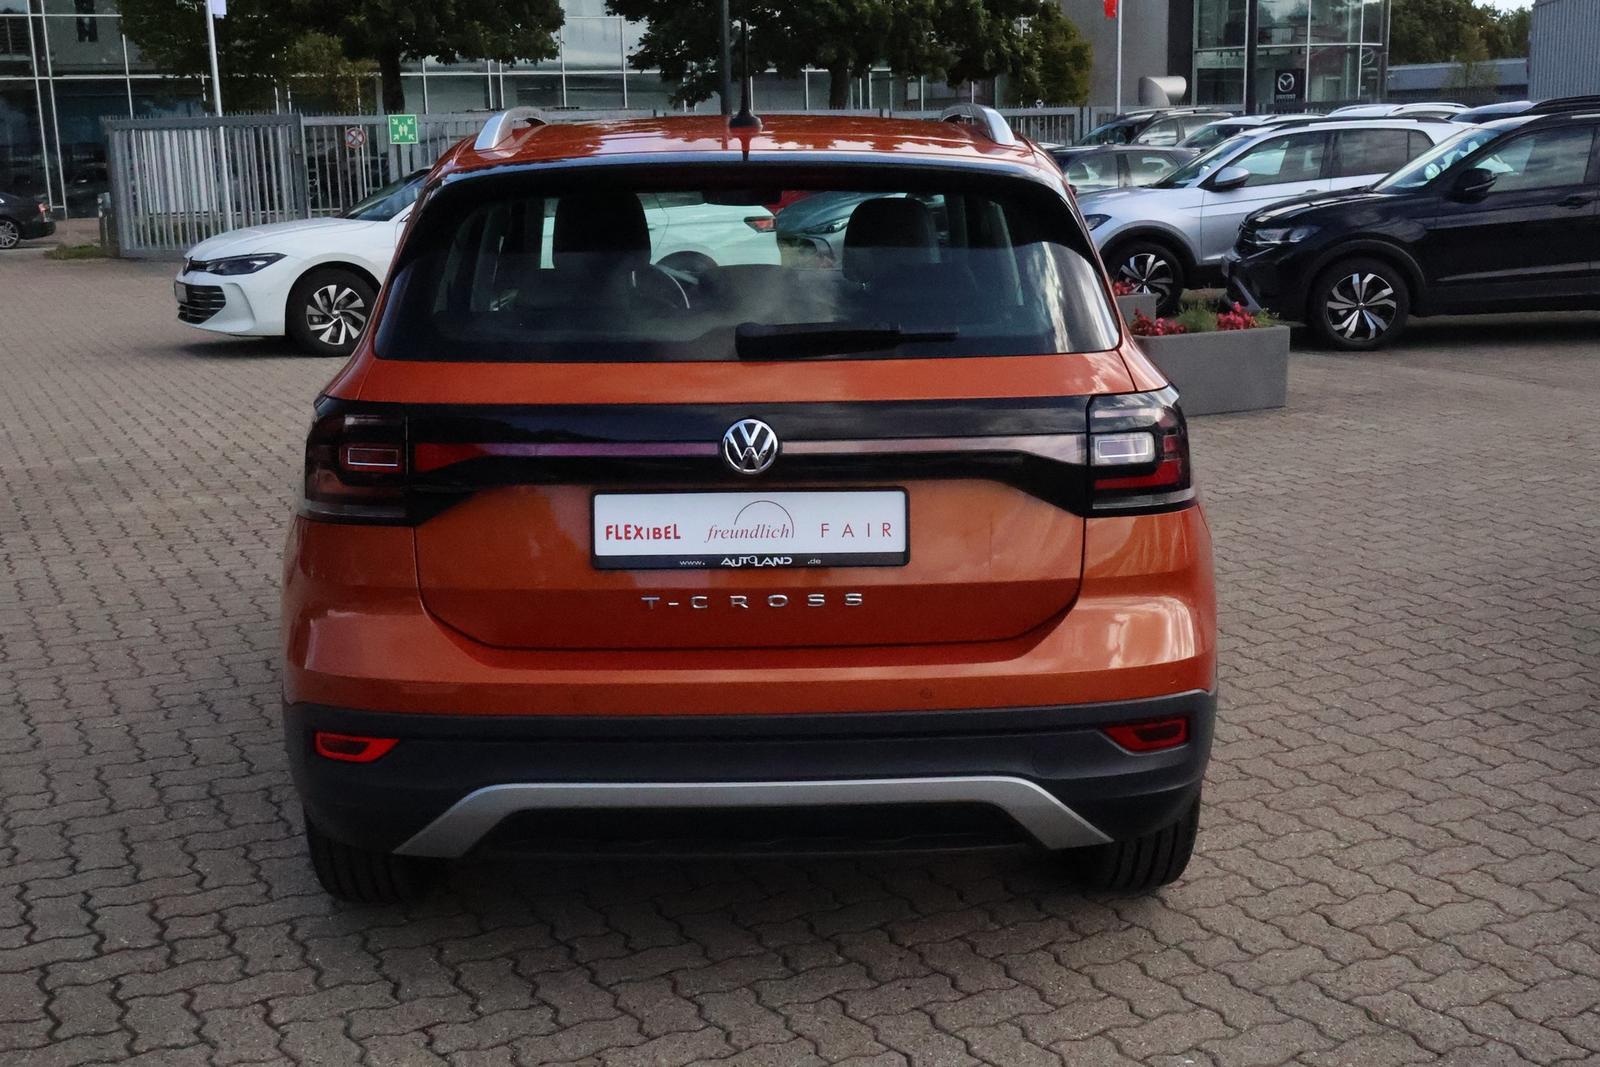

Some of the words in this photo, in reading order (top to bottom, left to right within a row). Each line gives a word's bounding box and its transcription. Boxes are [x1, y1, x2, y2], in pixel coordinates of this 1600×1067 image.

[605, 523, 681, 541] FLEXIBEL
[704, 523, 791, 544] freundlich
[820, 522, 892, 538] FAIR
[720, 556, 793, 567] AUTOLAND
[640, 592, 863, 610] T-CROSS
